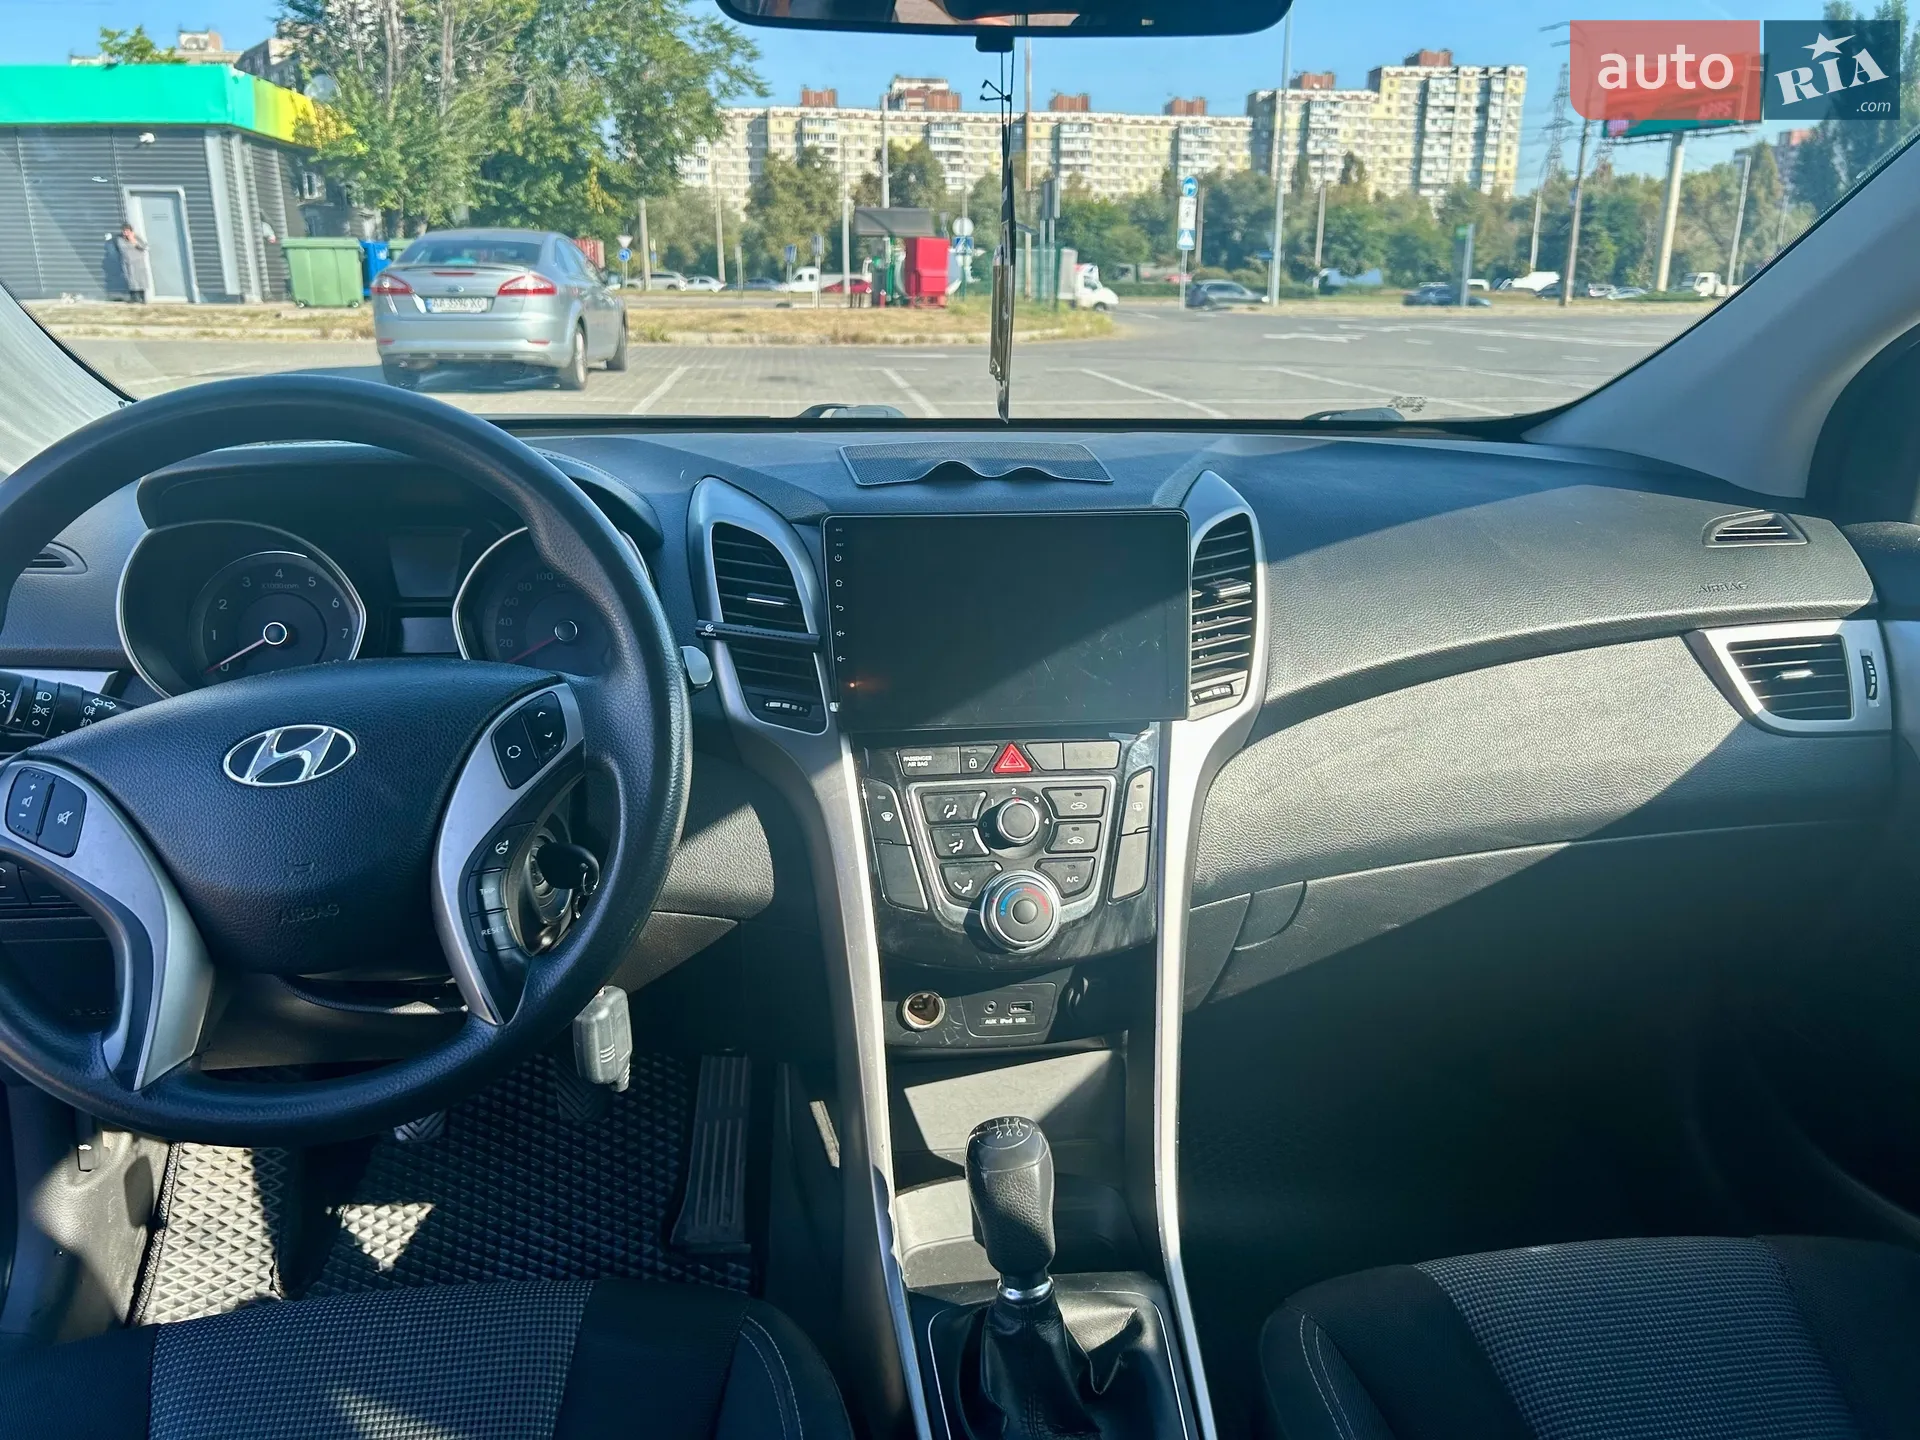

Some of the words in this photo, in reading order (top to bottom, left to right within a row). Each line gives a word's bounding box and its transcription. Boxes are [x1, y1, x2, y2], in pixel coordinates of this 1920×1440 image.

[274, 569, 284, 578] 4
[536, 572, 554, 581] 100
[242, 577, 251, 588] 3
[308, 576, 316, 587] 5
[517, 582, 532, 591] 80
[218, 599, 228, 609] 2
[331, 597, 340, 608] 6
[504, 597, 519, 607] 60
[498, 617, 512, 626] 40
[211, 629, 217, 640] 1
[341, 628, 348, 639] 7
[499, 638, 513, 647] 20
[479, 887, 496, 896] TRIP
[480, 925, 505, 936] RESET
